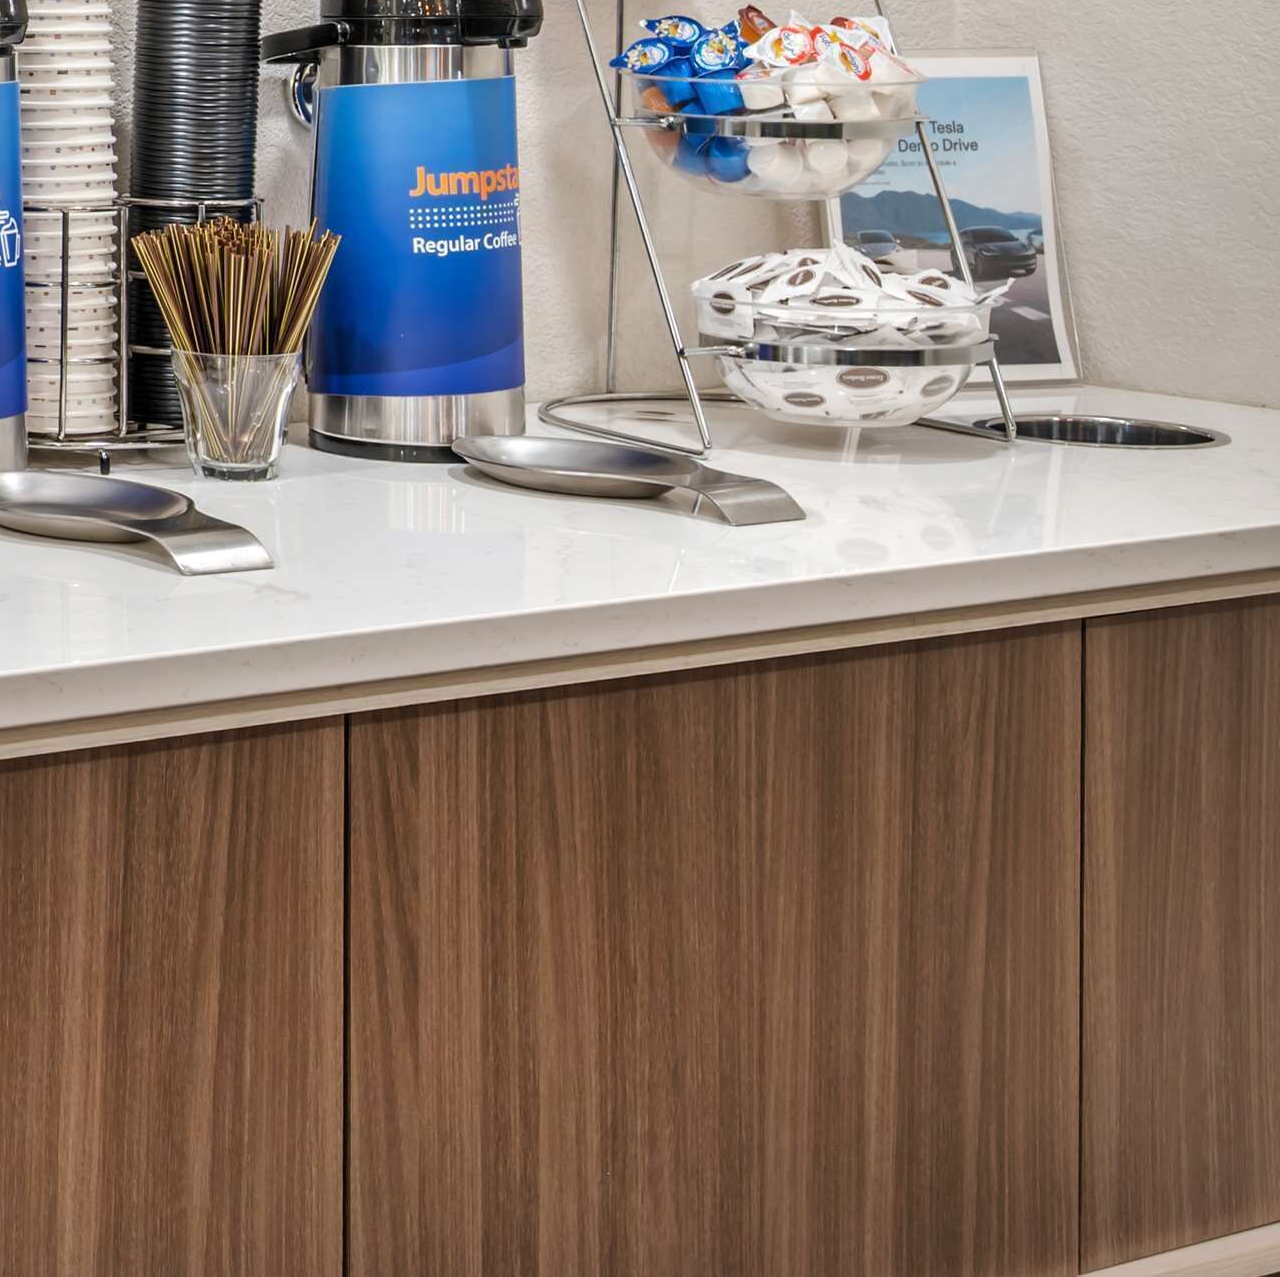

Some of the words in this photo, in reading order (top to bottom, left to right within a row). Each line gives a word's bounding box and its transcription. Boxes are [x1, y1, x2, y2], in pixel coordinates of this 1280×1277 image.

[929, 120, 964, 134] Tesla
[943, 138, 978, 152] Drive
[409, 163, 519, 201] Jumpsta
[412, 234, 481, 257] Regular
[483, 230, 517, 250] Coffee
